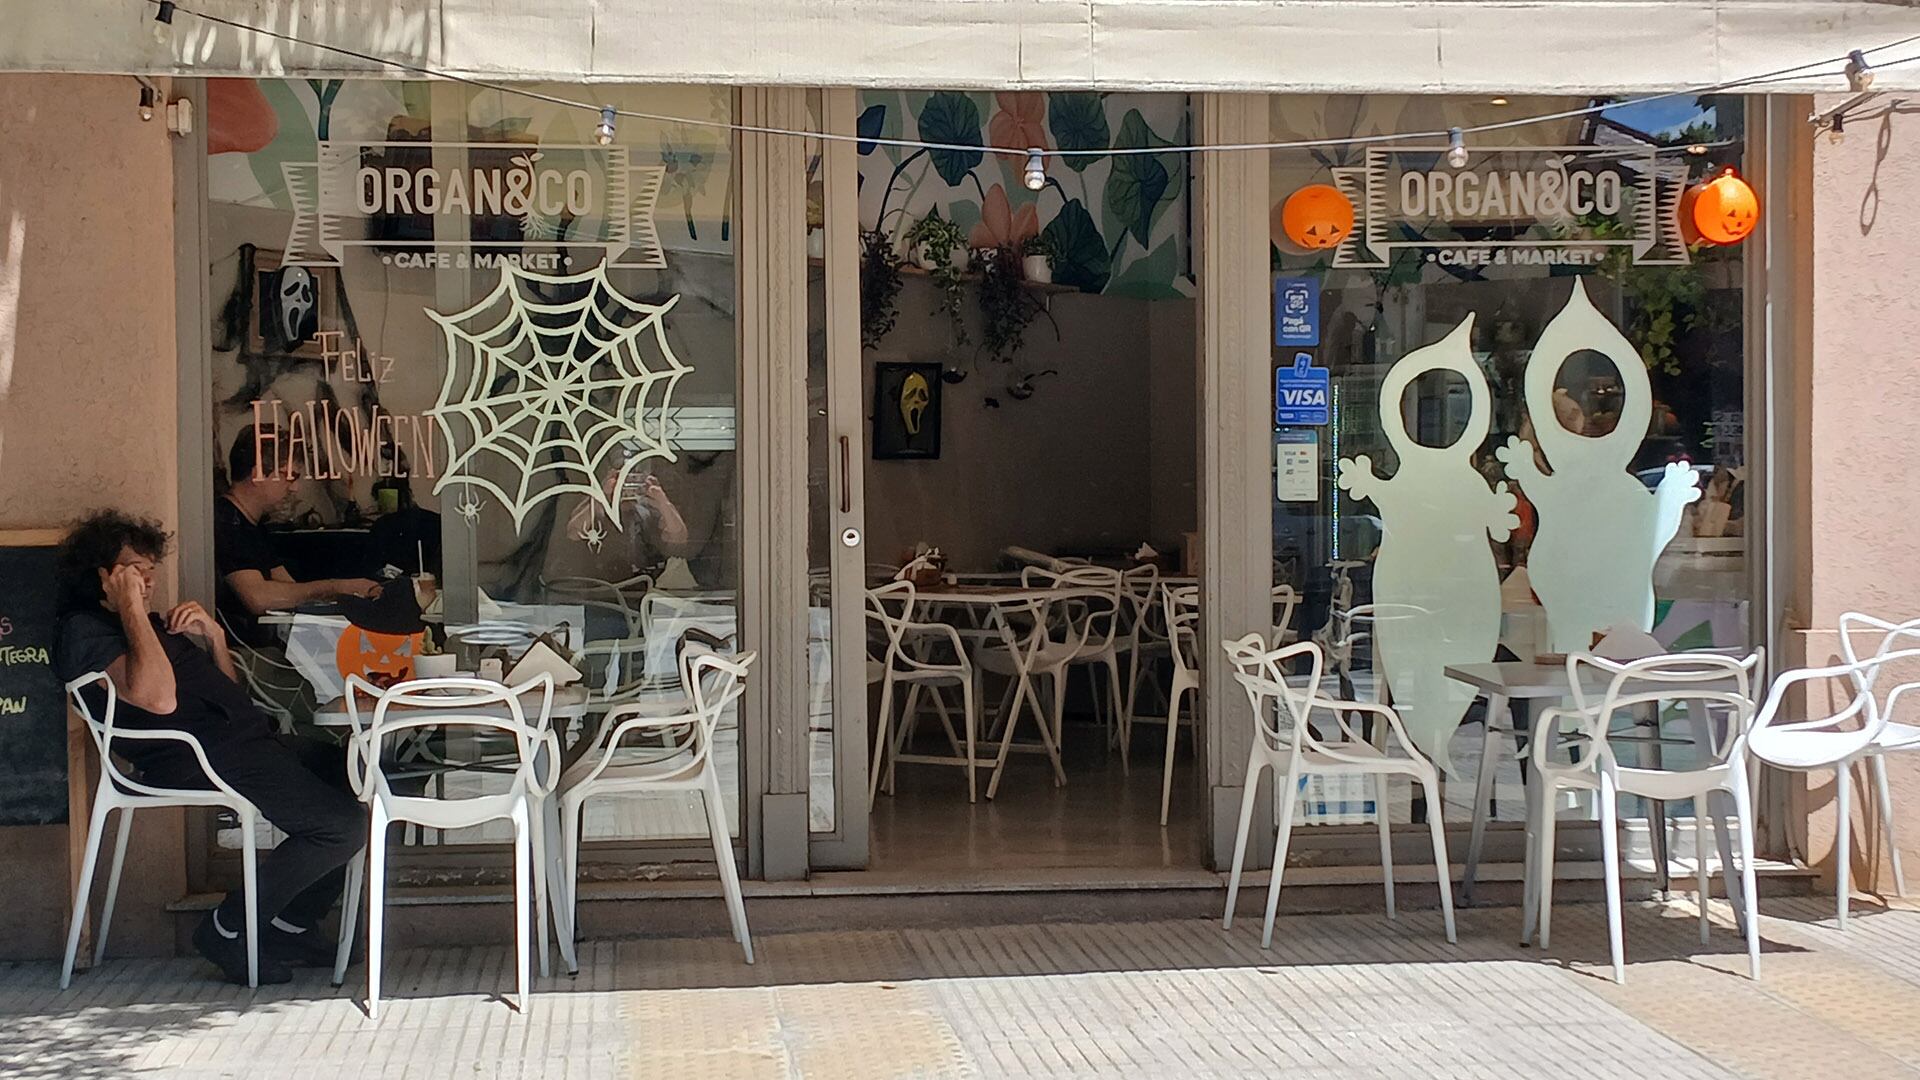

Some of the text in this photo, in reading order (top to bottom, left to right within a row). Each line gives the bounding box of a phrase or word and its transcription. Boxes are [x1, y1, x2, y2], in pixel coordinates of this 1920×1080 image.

[356, 167, 593, 217] ORGAN&CO
[1400, 170, 1622, 217] ORGAN&CO
[394, 252, 562, 270] CAFE & MARKET
[1438, 250, 1595, 266] CAFE & MARKET
[1279, 389, 1326, 406] VISA
